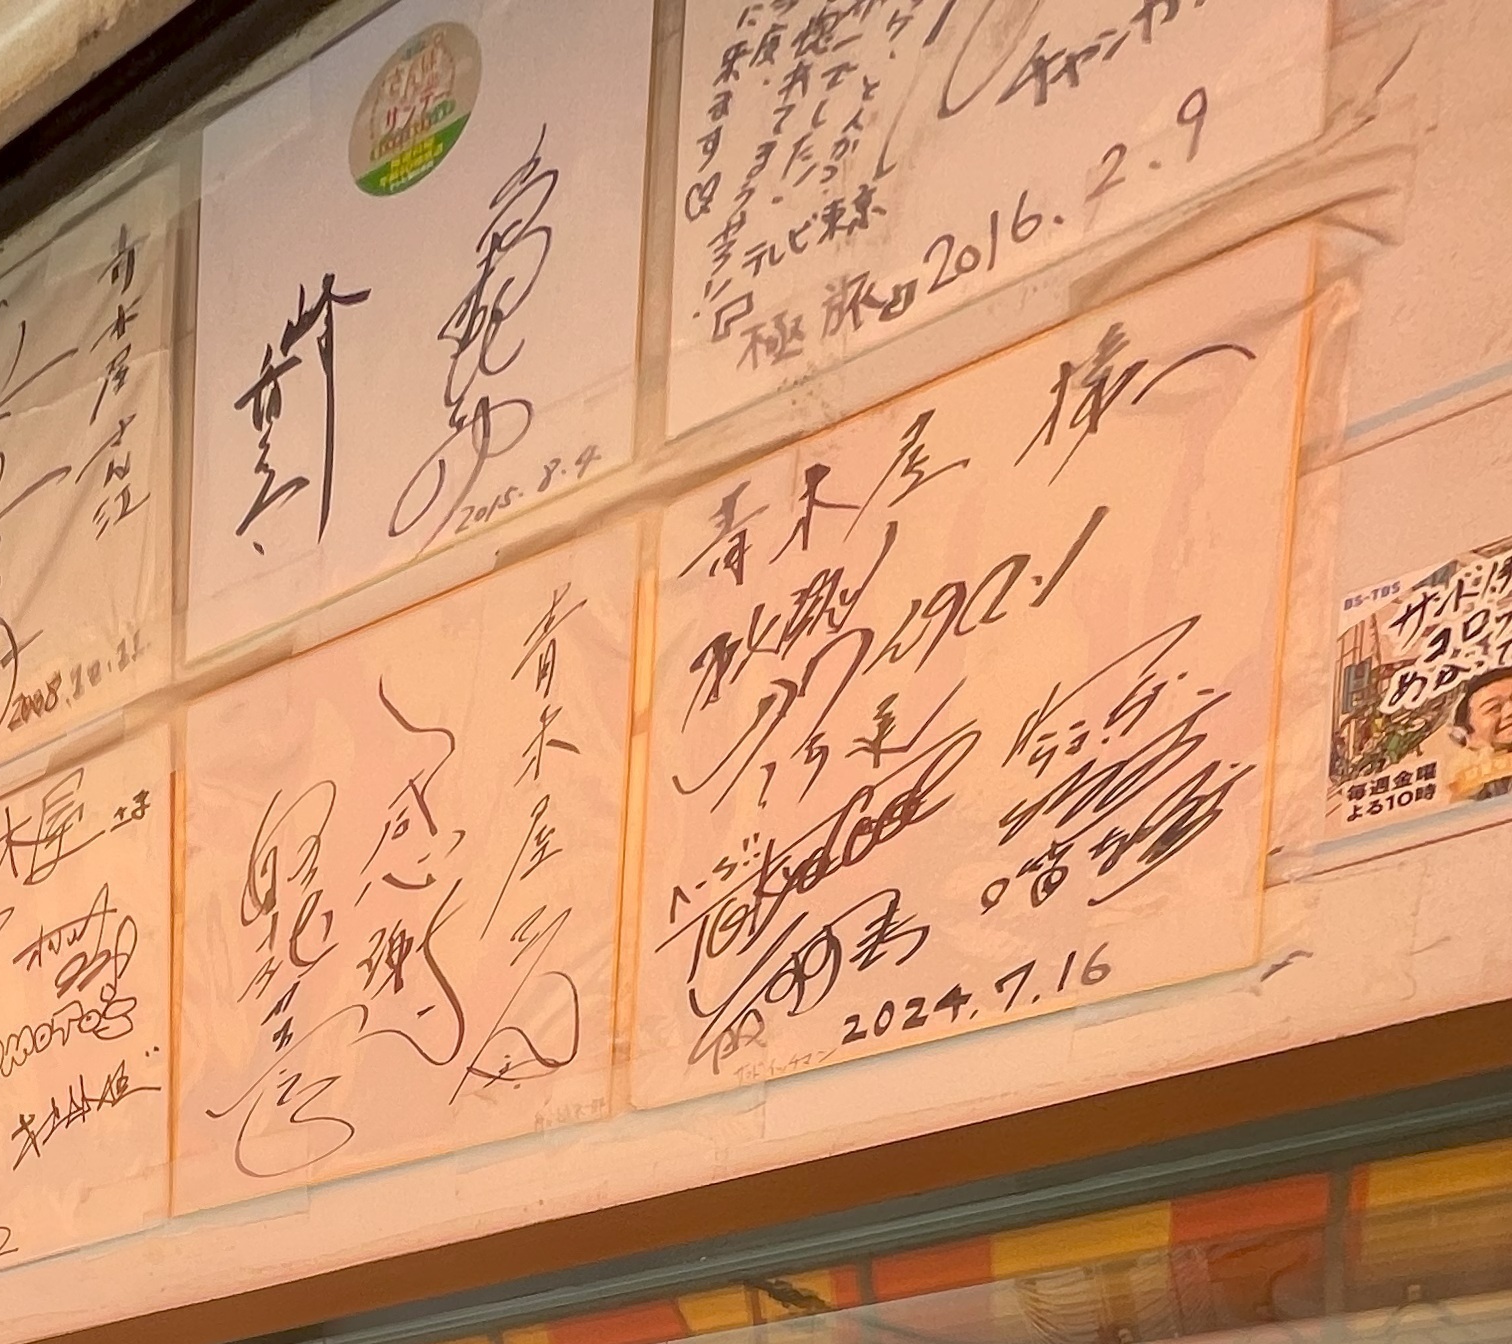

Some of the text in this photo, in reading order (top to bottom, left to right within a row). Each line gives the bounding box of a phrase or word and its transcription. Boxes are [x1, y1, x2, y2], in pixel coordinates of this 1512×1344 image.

[1346, 761, 1438, 803] 毎週金曜
[844, 943, 1111, 1043] 2024.7.16
